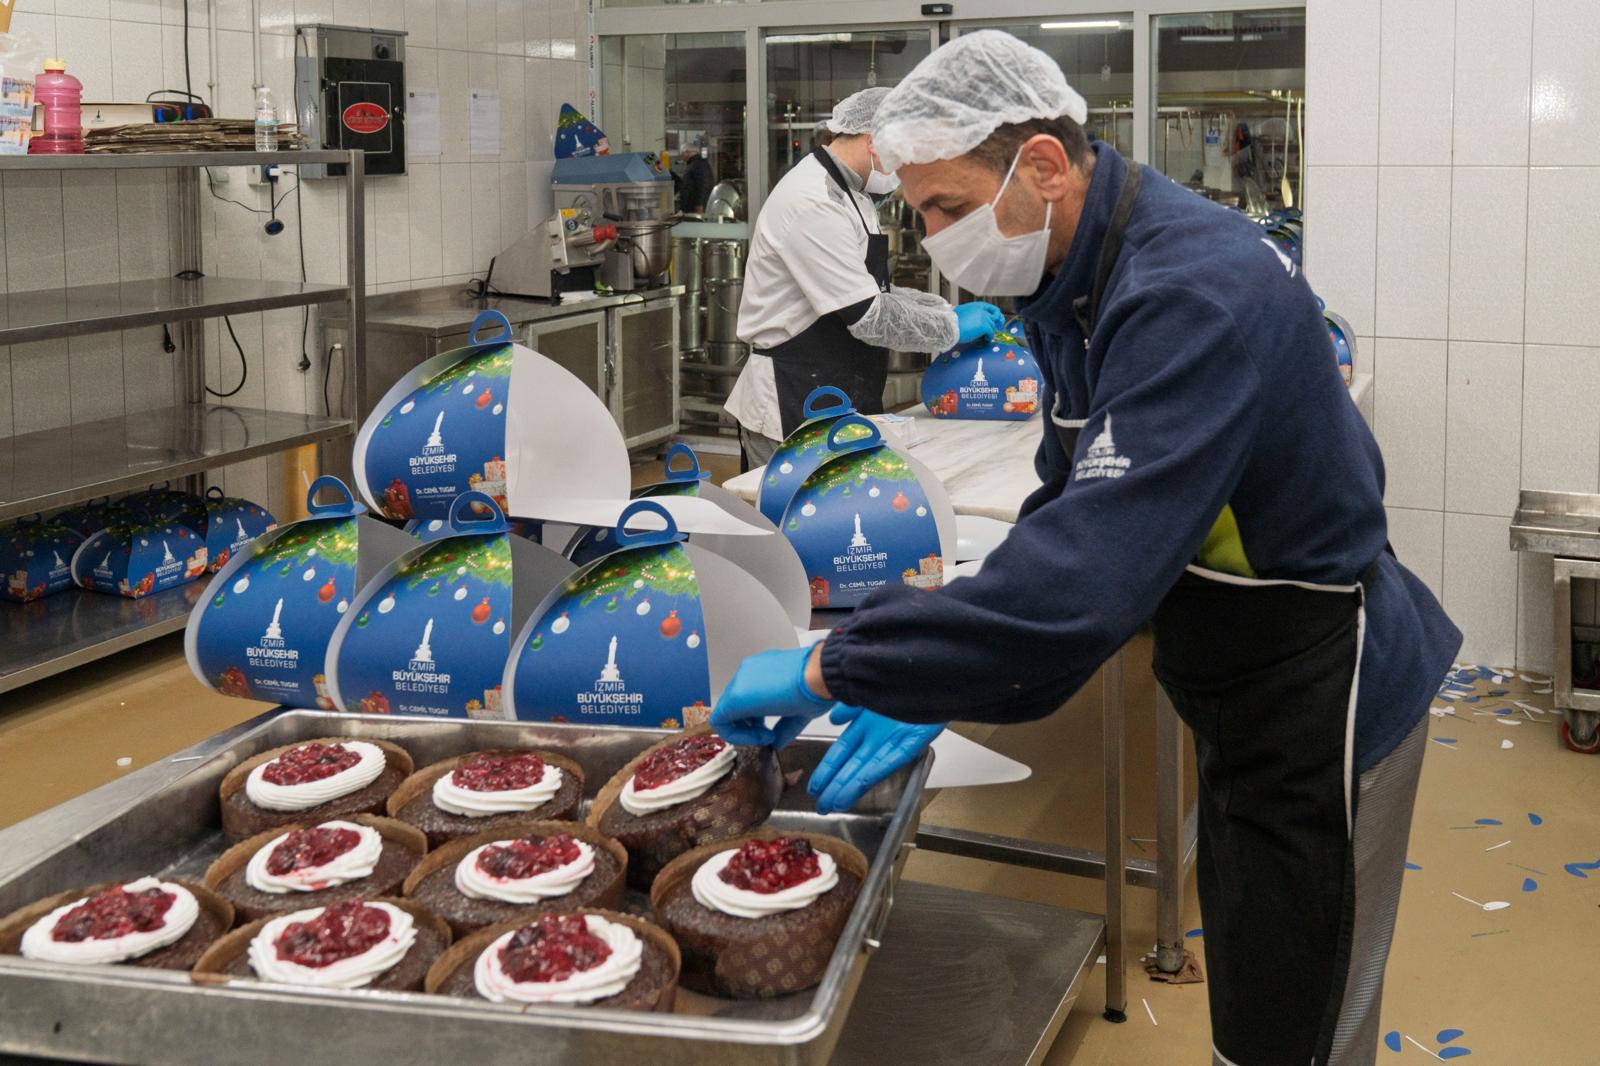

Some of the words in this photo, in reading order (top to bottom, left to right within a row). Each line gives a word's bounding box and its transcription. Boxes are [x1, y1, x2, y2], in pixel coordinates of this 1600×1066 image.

[422, 446, 445, 455] İZMİR
[409, 454, 457, 467] BÜYÜKŞEHİR
[411, 464, 455, 475] BELEDİYESİ
[847, 545, 873, 555] İZMİR
[833, 552, 888, 565] BÜYÜKŞEHİR
[836, 561, 886, 573] BELEDİYESİ
[260, 638, 285, 648] İZMİR
[246, 646, 299, 660] BÜYÜKŞEHİR
[249, 657, 297, 669] BELEDİYESİ
[408, 661, 436, 672] İZMİR
[392, 669, 451, 684] BÜYÜKŞEHİR
[395, 681, 448, 694] BELEDİYESİ
[594, 681, 625, 692] İZMİR
[577, 691, 644, 704] BÜYÜKŞEHİR
[580, 704, 641, 715] BELEDİYESİ
